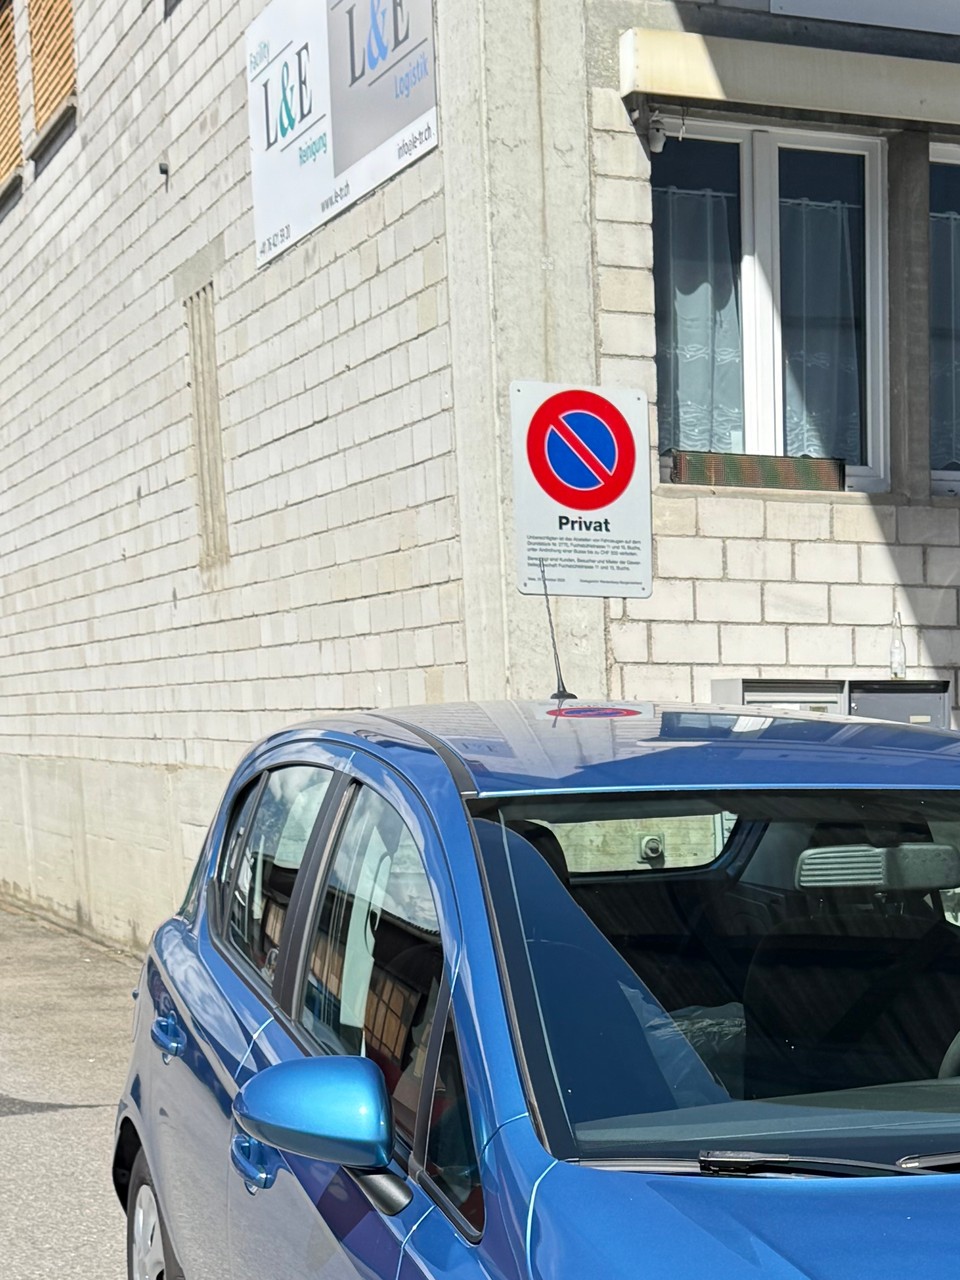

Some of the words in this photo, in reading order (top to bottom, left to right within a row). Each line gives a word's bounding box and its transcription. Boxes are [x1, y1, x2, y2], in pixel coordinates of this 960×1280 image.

[345, 0, 410, 88] L&E
[394, 52, 429, 99] Logistik
[262, 42, 313, 152] L&E
[558, 516, 611, 533] Privat
